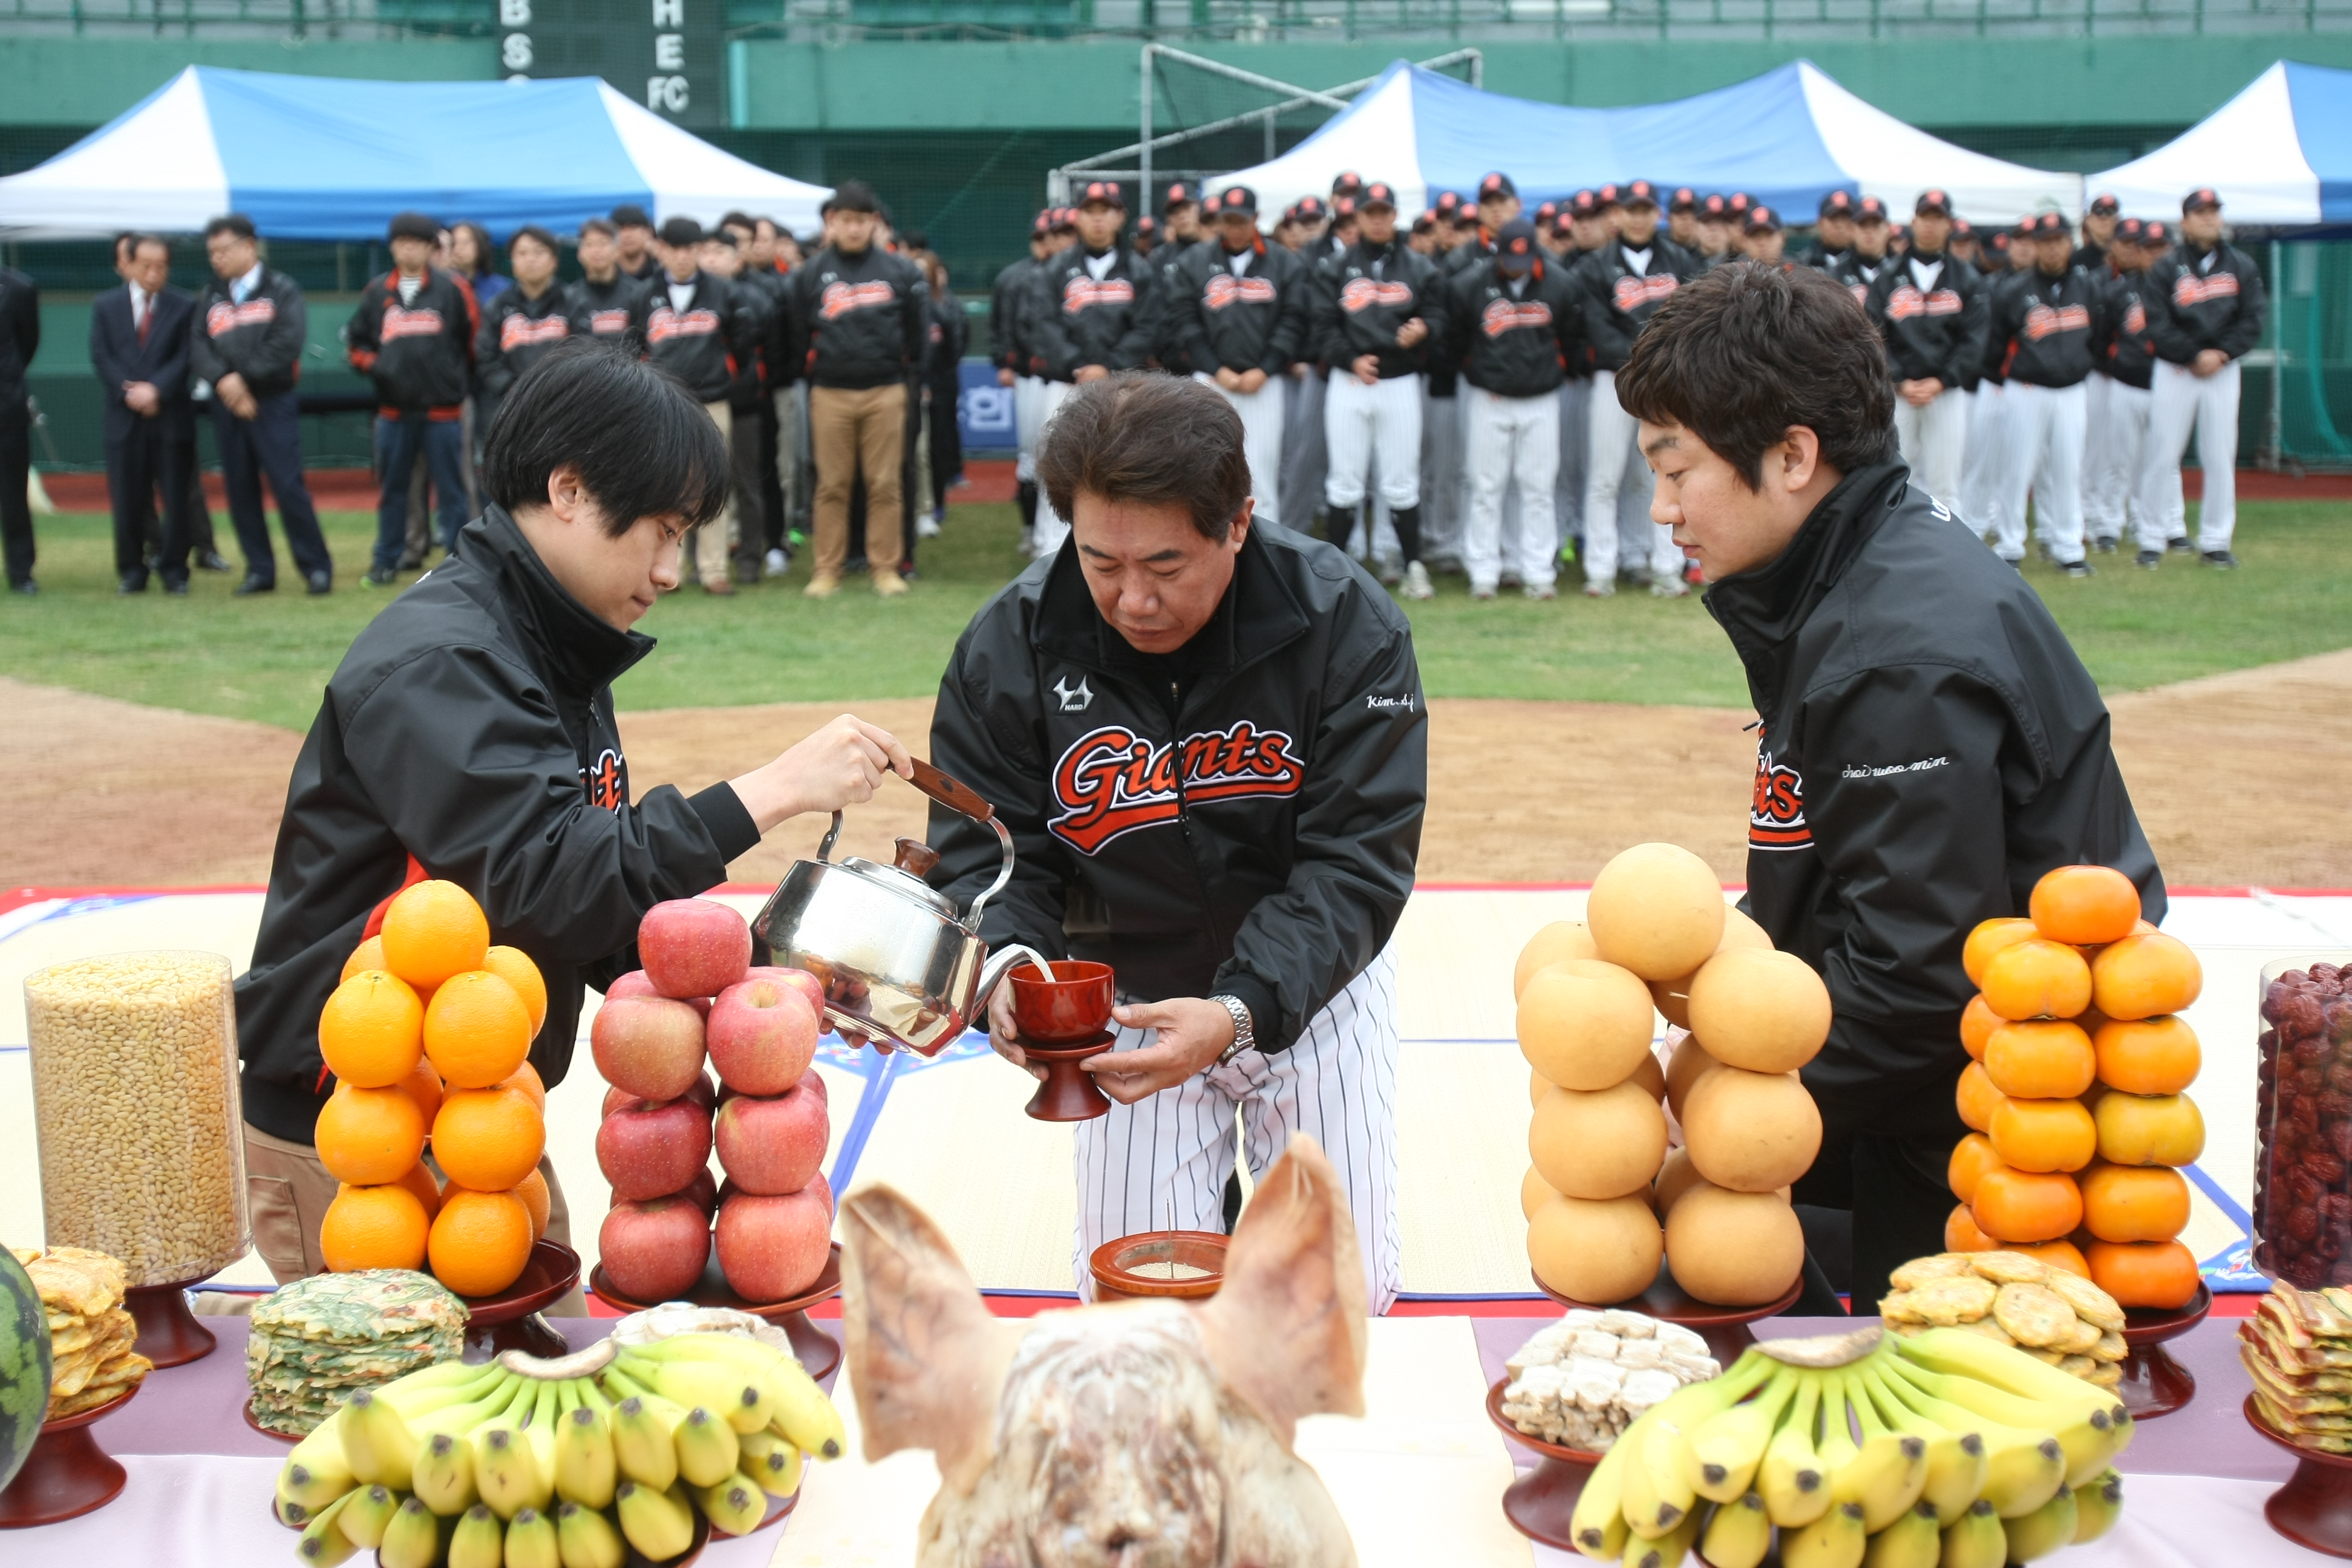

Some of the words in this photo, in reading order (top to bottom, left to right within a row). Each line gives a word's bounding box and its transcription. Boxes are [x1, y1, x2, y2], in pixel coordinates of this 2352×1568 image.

[502, 32, 534, 71] S
[655, 33, 685, 70] E
[647, 74, 690, 113] FC
[1047, 720, 1305, 857] Giants
